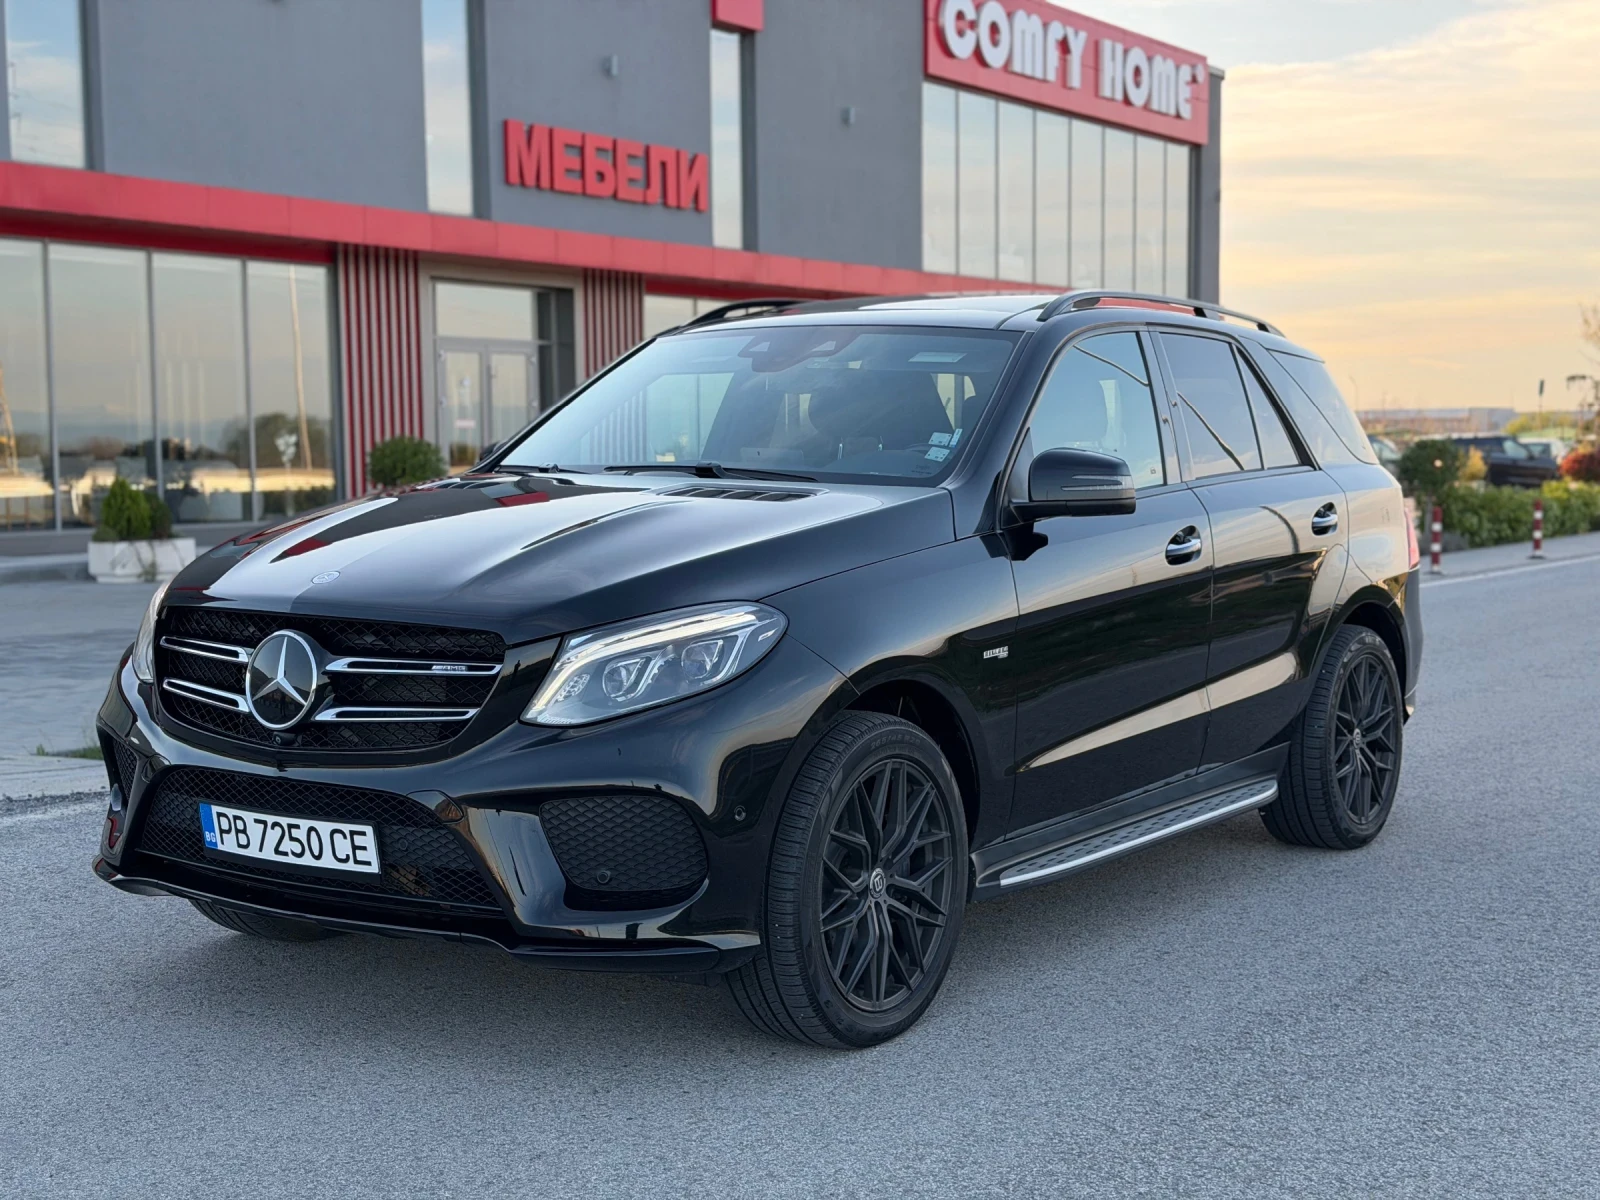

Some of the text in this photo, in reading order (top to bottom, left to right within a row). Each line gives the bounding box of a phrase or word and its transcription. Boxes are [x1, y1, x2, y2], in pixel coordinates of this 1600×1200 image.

[503, 118, 709, 213] МЕБЕЛИ
[205, 831, 216, 843] BG
[216, 811, 372, 867] PB 7250 CE
